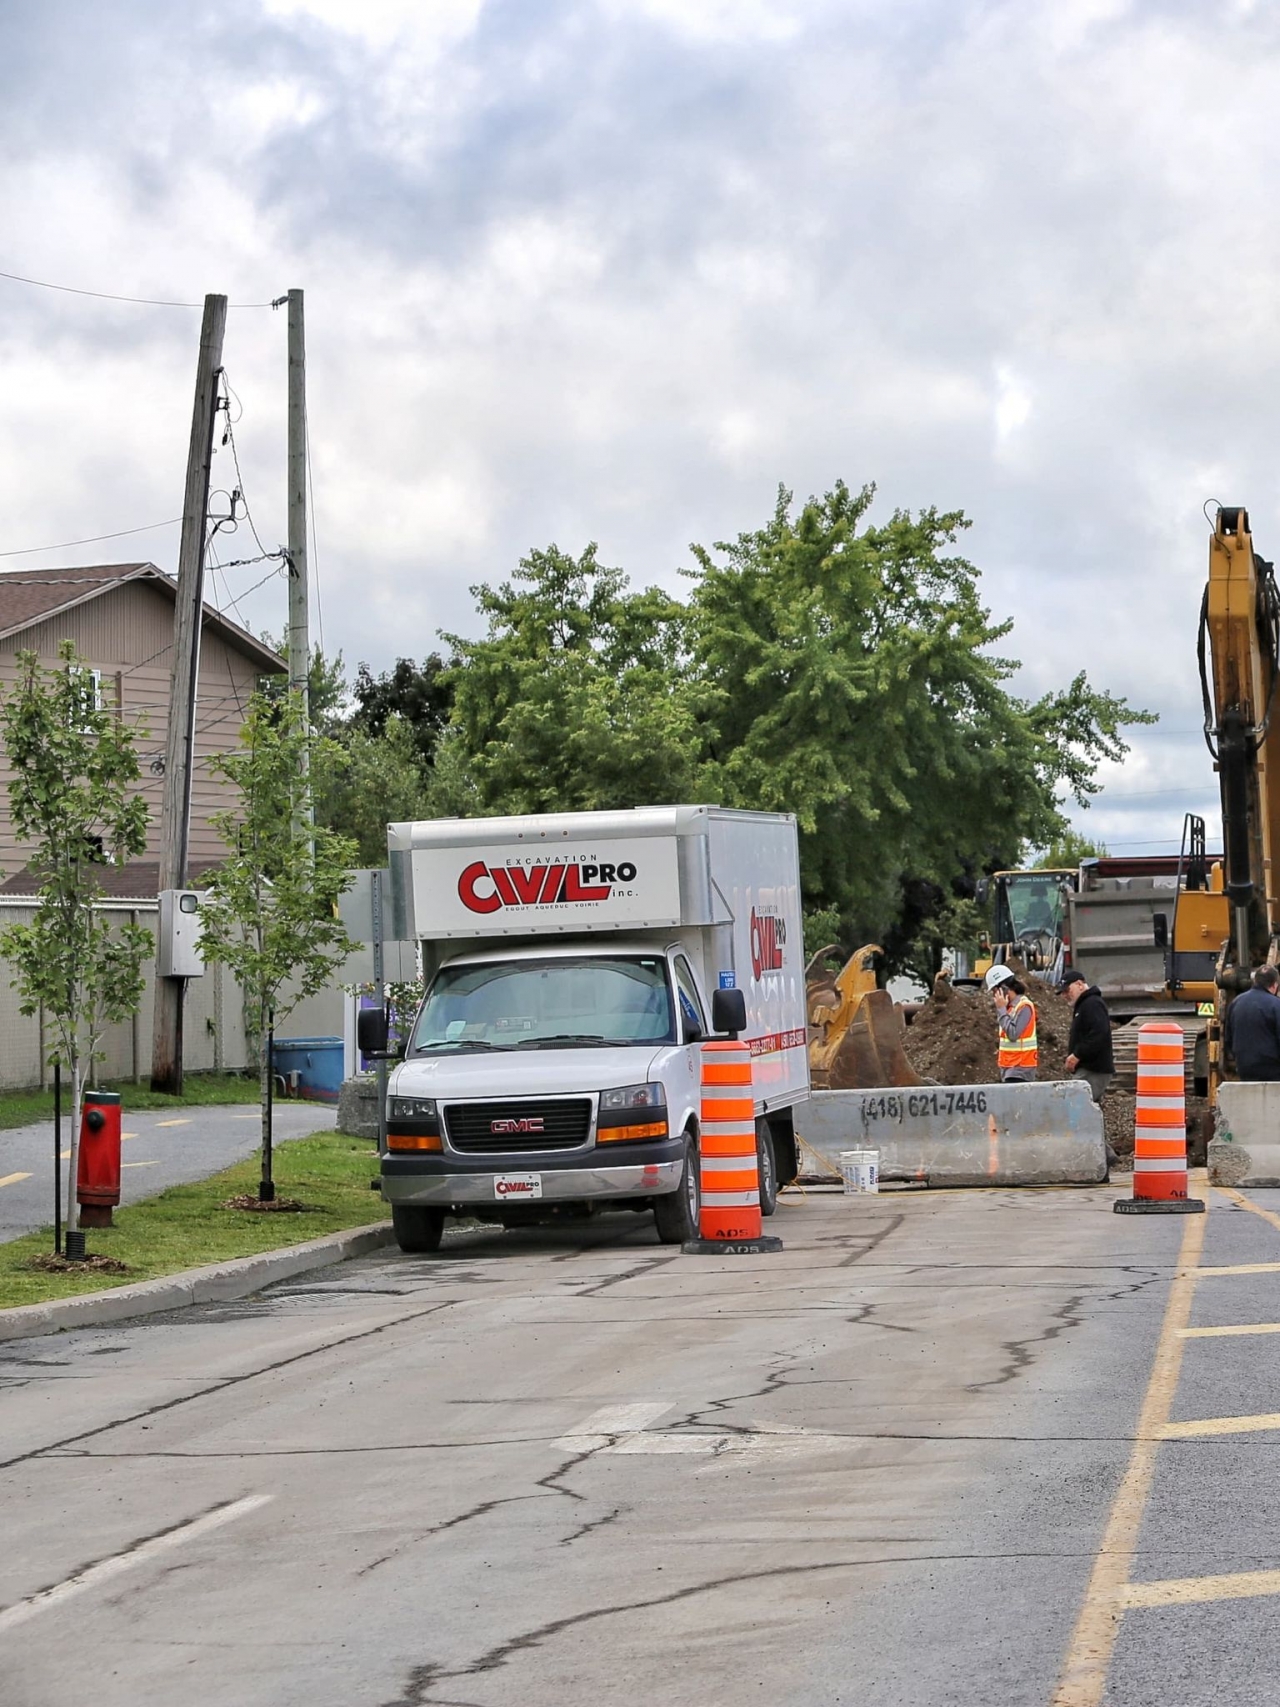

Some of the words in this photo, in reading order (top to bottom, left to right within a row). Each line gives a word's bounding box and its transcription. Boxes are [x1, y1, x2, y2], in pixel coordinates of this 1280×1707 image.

[506, 854, 598, 866] EXCAVATION
[458, 861, 612, 914] CIVIL
[582, 862, 637, 884] PRO
[612, 888, 638, 897] inc.
[908, 1091, 987, 1117] 621-7446
[491, 1117, 545, 1133] GMC
[715, 1228, 749, 1238] ADS
[723, 1245, 760, 1254] ADS
